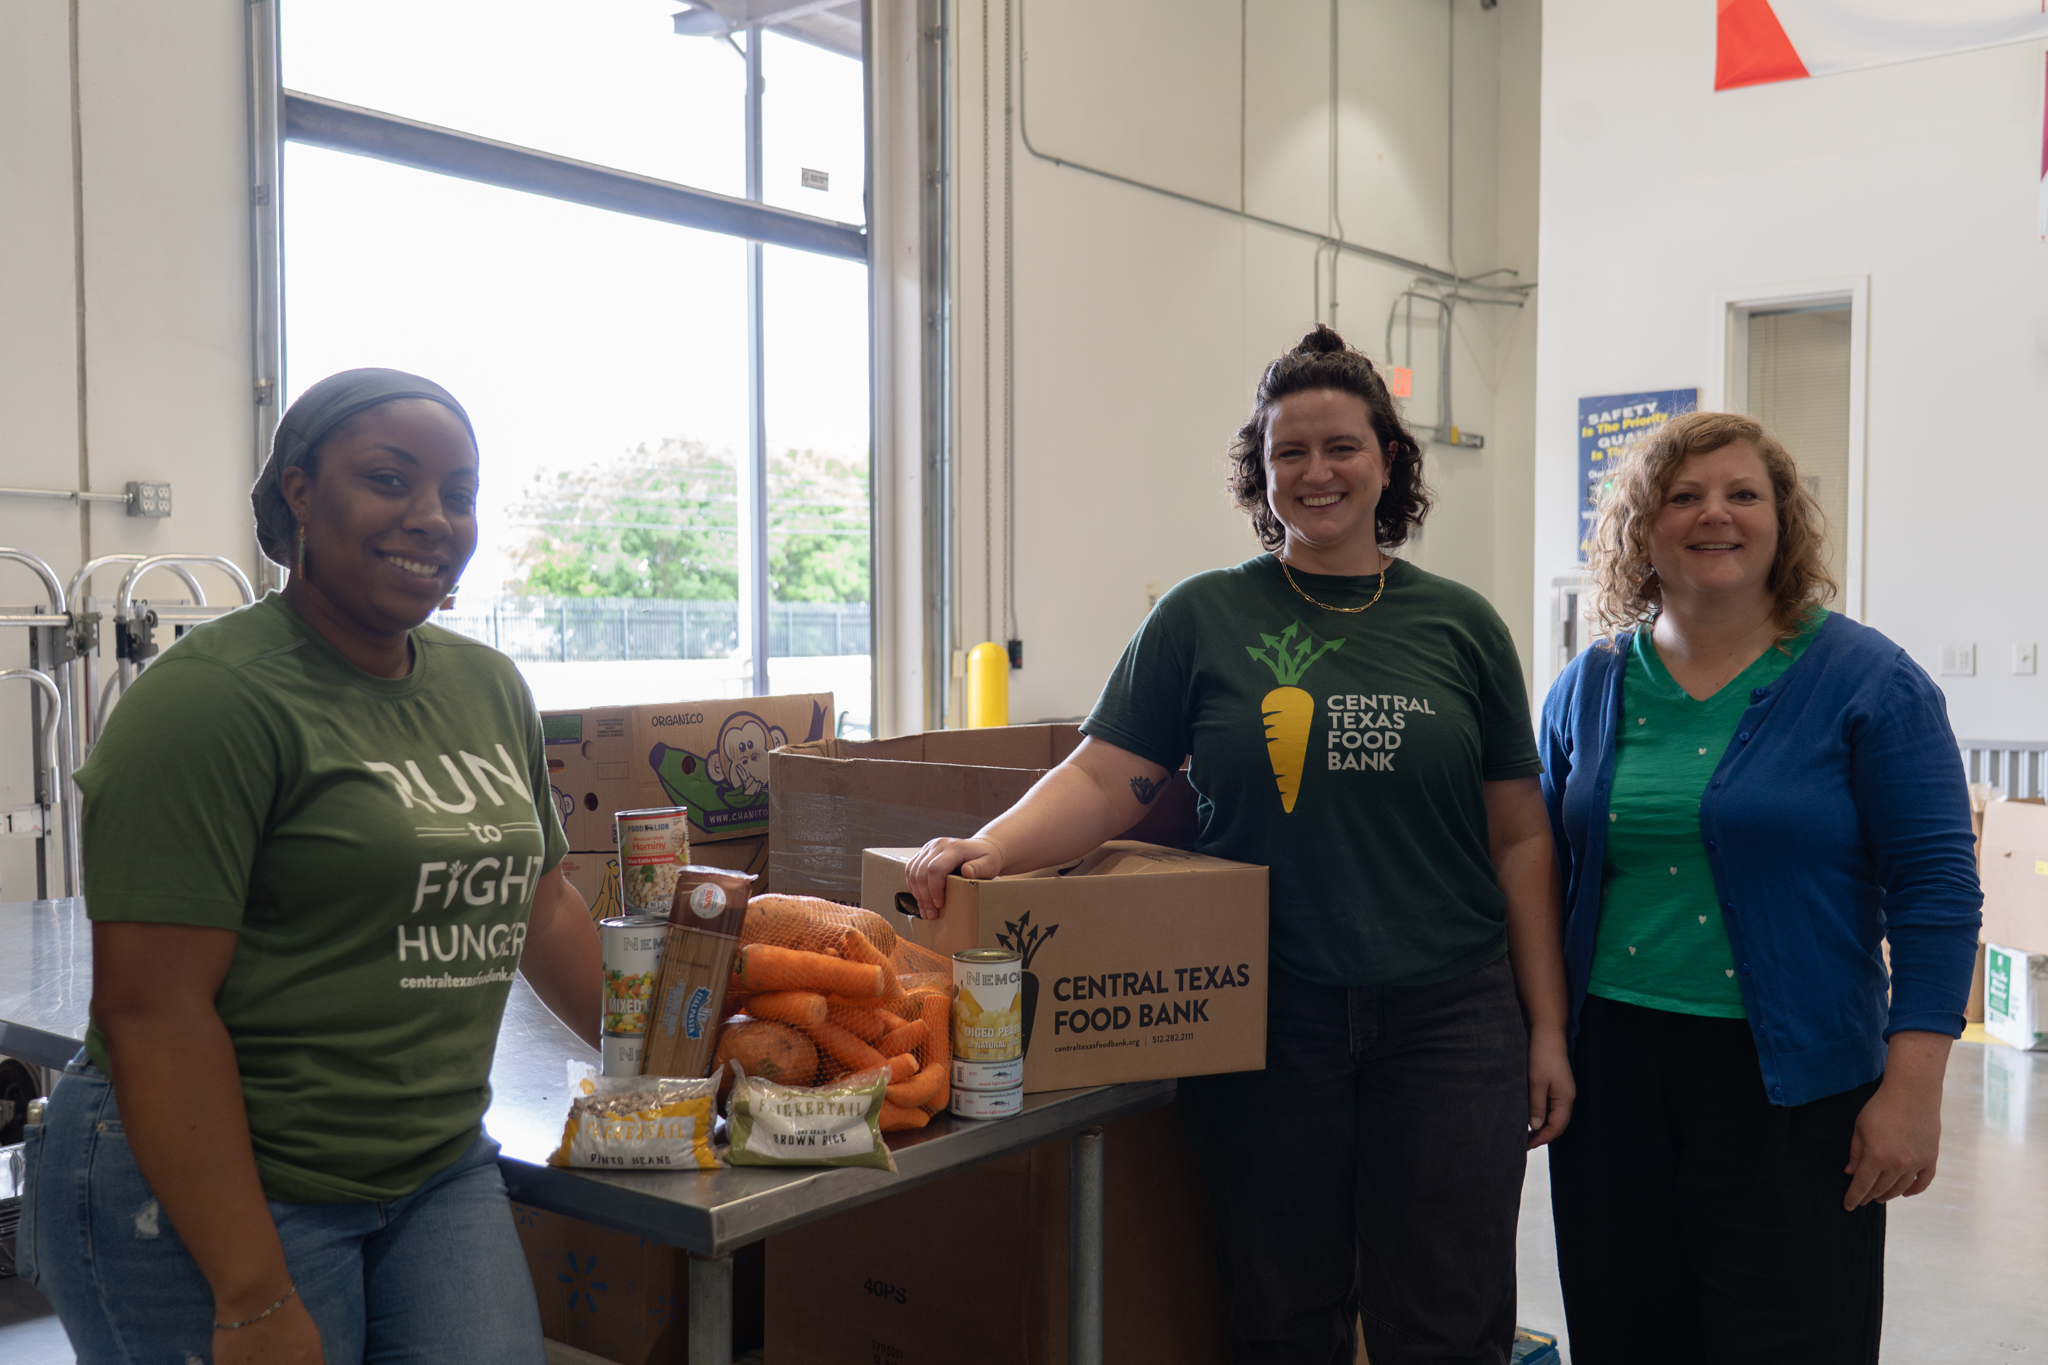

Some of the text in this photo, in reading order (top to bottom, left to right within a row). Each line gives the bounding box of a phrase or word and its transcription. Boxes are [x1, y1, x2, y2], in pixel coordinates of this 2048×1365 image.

[1587, 402, 1658, 426] SAFETY
[1597, 421, 1620, 436] The
[1622, 413, 1669, 430] Priority
[1326, 694, 1436, 715] CENTRAL
[651, 713, 704, 727] ORGANICO
[1327, 712, 1406, 729] TEXAS
[1327, 731, 1401, 750] FOOD
[1327, 751, 1395, 772] BANK
[468, 822, 502, 843] to
[654, 823, 670, 831] LION
[632, 841, 667, 851] Hominy
[397, 921, 528, 962] HUNGER
[1053, 963, 1250, 1002] CENTRAL TEXAS
[609, 998, 642, 1014] MIXED
[688, 991, 704, 1034] ITALPASTA
[1054, 999, 1210, 1036] FOOD BANK
[965, 1026, 995, 1038] DICED
[976, 1040, 1006, 1049] NATURAL
[1054, 1033, 1194, 1052] centraltexasfoodbank.org 512.282.2111
[773, 1133, 847, 1146] BROWN RICE
[591, 1153, 671, 1165] PINTO BEANS
[864, 1278, 907, 1304] 40PS
